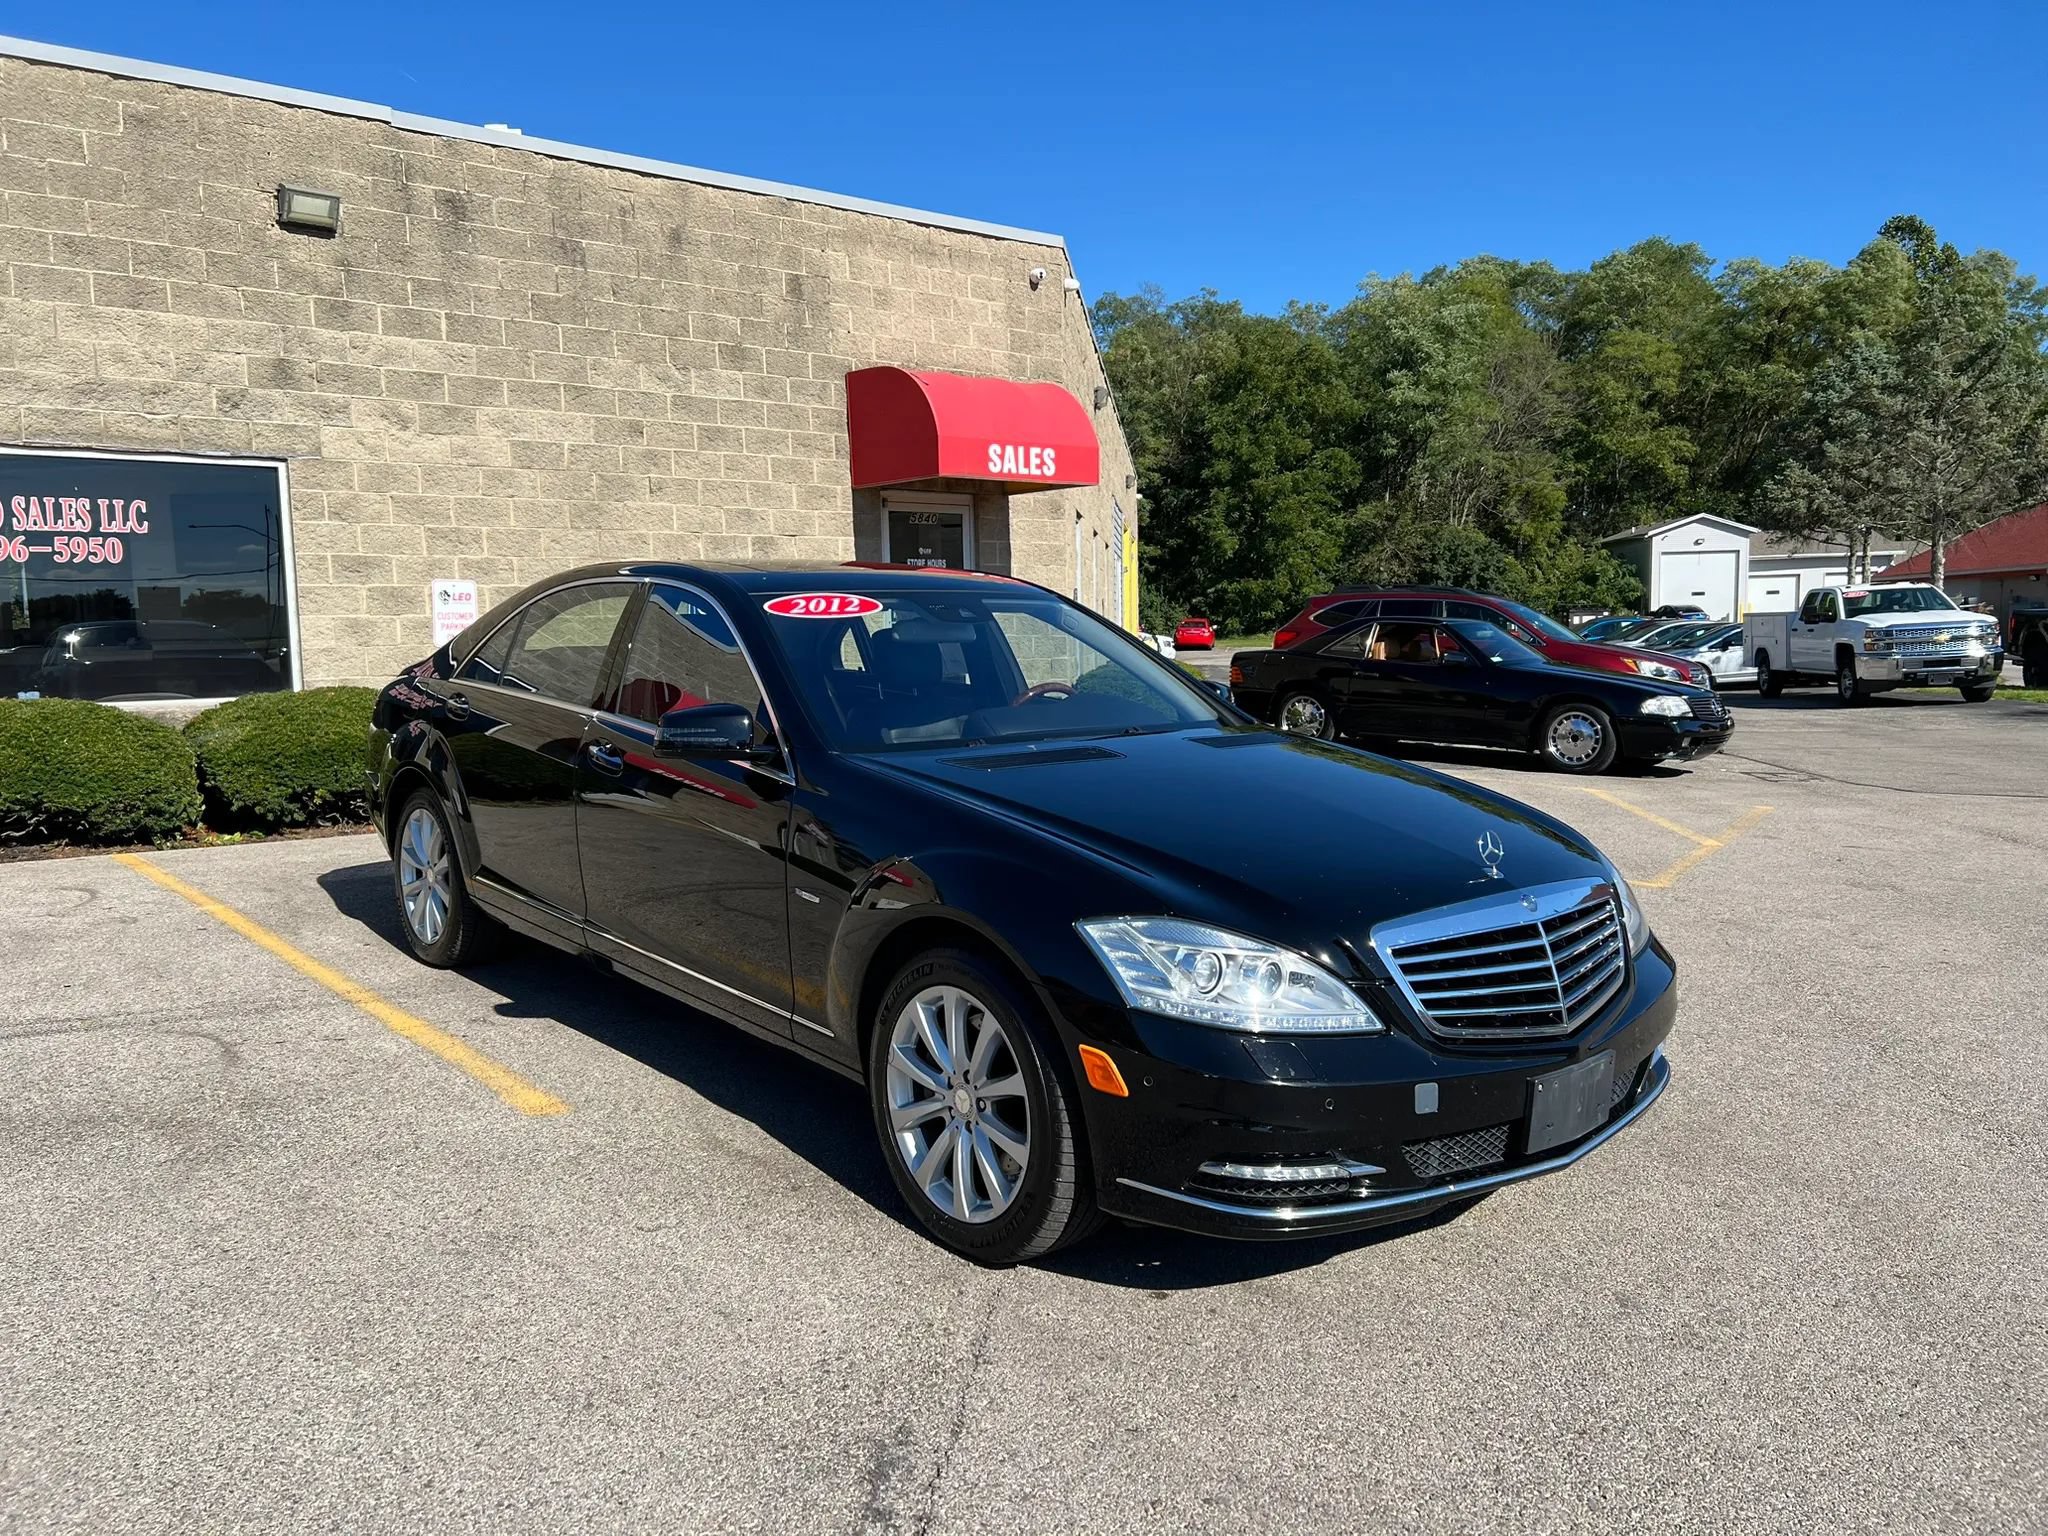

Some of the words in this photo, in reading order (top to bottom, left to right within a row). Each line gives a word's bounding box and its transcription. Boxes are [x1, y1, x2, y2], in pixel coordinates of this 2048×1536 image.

[988, 443, 1056, 477] SALES
[11, 495, 92, 533] SALES
[97, 498, 149, 534] LLC
[909, 512, 939, 525] 5840
[907, 558, 926, 568] STORE
[927, 558, 947, 568] HOURS
[452, 592, 472, 601] LEO
[789, 597, 860, 614] 2012
[437, 612, 473, 620] CUSTOMER
